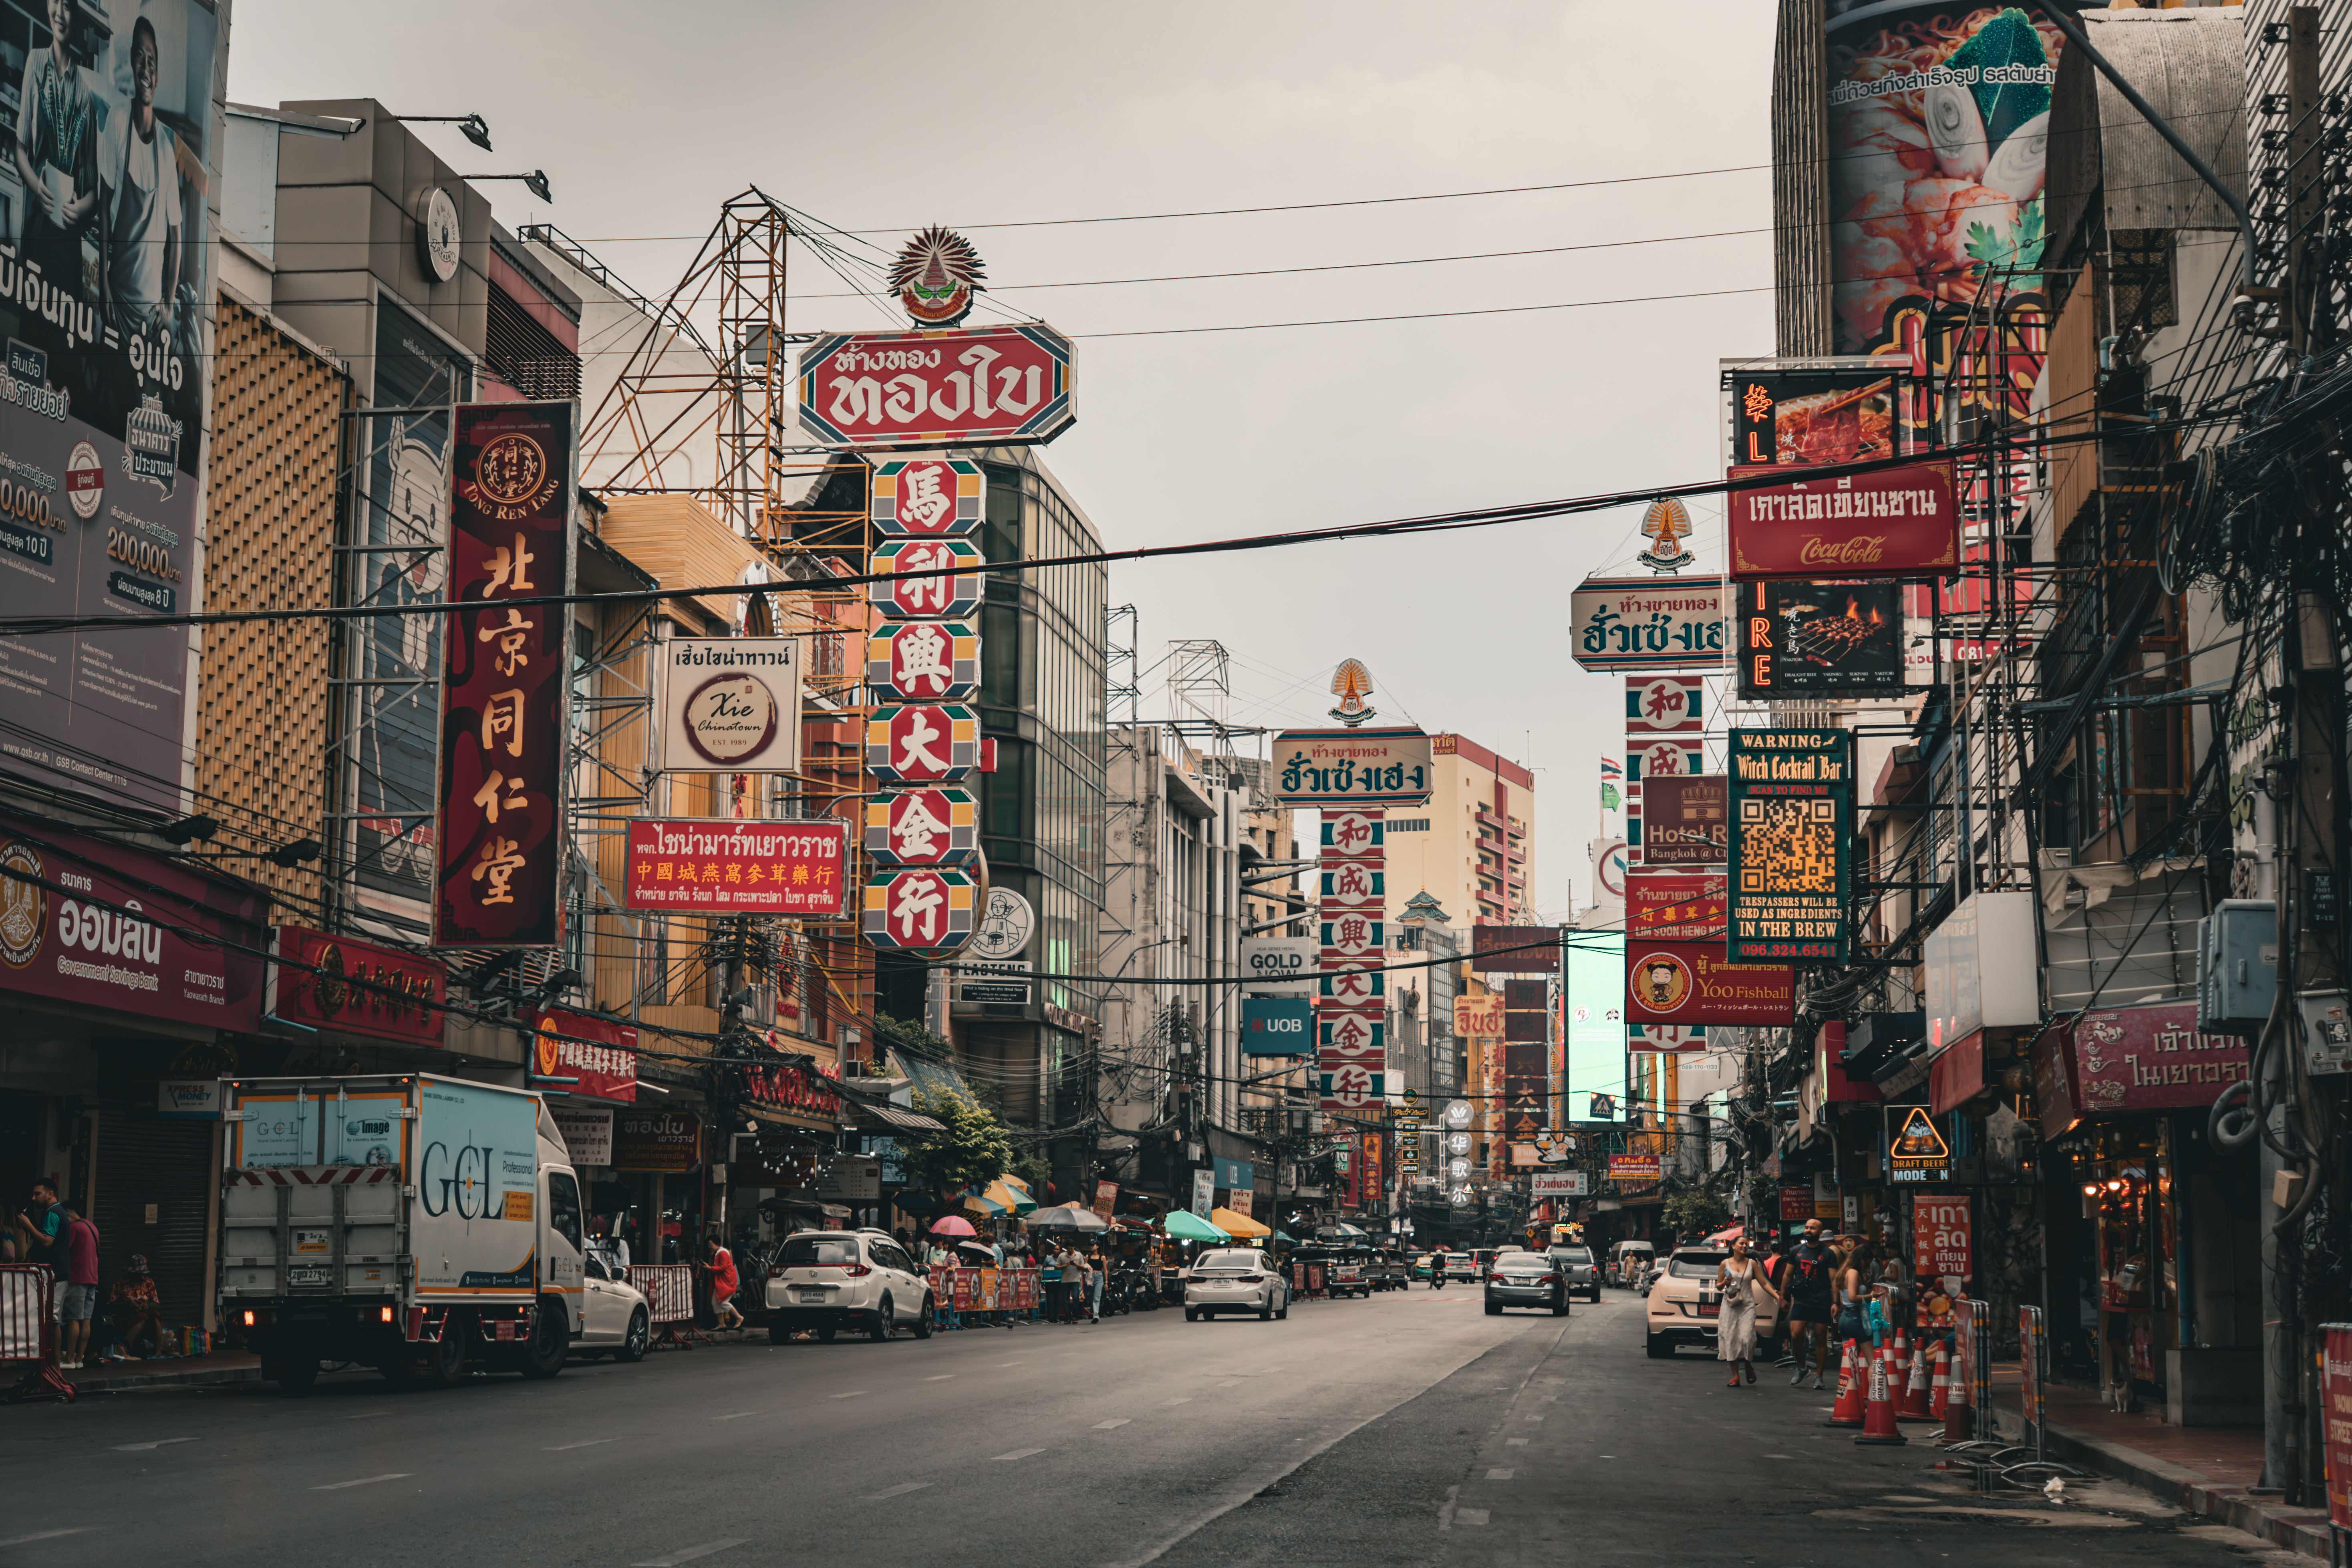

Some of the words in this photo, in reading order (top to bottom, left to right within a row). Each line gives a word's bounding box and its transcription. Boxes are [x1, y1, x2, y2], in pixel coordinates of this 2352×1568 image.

[1983, 62, 2056, 83] รสต้มยำ
[129, 321, 183, 390] อุ่นใจ
[834, 344, 941, 372] ห้างทอง
[12, 352, 40, 378] สินเชื่อ
[829, 344, 1043, 426] ทองใบ
[142, 392, 163, 413] สินเชื่อ
[131, 428, 169, 452] ธนาคาร
[135, 453, 173, 477] ประชาชน
[502, 445, 518, 497] 同仁堂
[17, 462, 57, 493] วงเงินกู้สูงสุด
[77, 473, 95, 488] รู้ก่อนกู้
[1749, 476, 1937, 521] เกาลัดเทียนซาน
[50, 514, 66, 532] บาท
[111, 505, 145, 529] เติมทุนค้าขาย
[147, 522, 179, 548] วงเงินกู้สูงสุด
[26, 535, 38, 554] 10
[40, 537, 47, 557] ปี
[107, 526, 169, 578] 200,000
[169, 566, 181, 583] บาท
[1800, 535, 1888, 565] Coca-Cola
[118, 579, 155, 605] ผ่อนนานสูงสุด
[156, 590, 161, 601] 8
[163, 589, 169, 608] ปี
[1619, 595, 1718, 613] ห้างขายทอง
[18, 645, 27, 654] MRR
[710, 692, 754, 719] Xie
[698, 720, 762, 732] Chinatown
[1311, 743, 1387, 758] ห้างขายทอง
[1741, 735, 1821, 748] WARNING
[3, 743, 48, 763] www.gsb.or.th
[56, 756, 70, 768] GSB
[71, 760, 94, 776] Contact
[95, 768, 113, 783] Center
[114, 774, 127, 787] 1115
[1736, 754, 1769, 780] Witch
[1772, 754, 1815, 781] Cocktail
[1818, 755, 1842, 780] Bar
[1750, 785, 1774, 794] SCAN
[1775, 786, 1788, 794] TO
[1789, 785, 1812, 794] FIND
[1814, 785, 1828, 794] ME
[1650, 848, 1697, 860] Bangkok
[1700, 849, 1712, 859] @
[61, 872, 92, 892] ธนาคาร
[635, 886, 665, 901] จำหน่าย
[669, 887, 689, 901] ยาจีน
[692, 887, 712, 902] รังนก
[715, 886, 730, 902] โสม
[733, 890, 782, 904] กระเพาะปลา
[785, 888, 805, 904] ใบชา
[807, 890, 834, 909] สุราจีน
[1636, 886, 1697, 901] ร้านขายยา
[1740, 897, 1799, 906] TRESPASSERS
[1801, 897, 1824, 906] WILL
[1826, 897, 1837, 906] BE
[1735, 908, 1759, 919] USED
[1761, 908, 1774, 918] AS
[1776, 908, 1843, 919] INGREDIENTS
[59, 900, 162, 964] ออมสิน
[1635, 926, 1651, 937] LIM
[1654, 925, 1679, 936] SOON
[1682, 925, 1707, 936] HENG
[1739, 922, 1756, 937] IN
[1760, 922, 1790, 937] THE
[1795, 922, 1837, 937] BREW
[1741, 944, 1836, 956] 096.324.6541
[1250, 953, 1303, 969] GOLD
[58, 955, 109, 982] Government
[109, 965, 139, 990] Savings
[139, 972, 159, 992] Bank
[184, 968, 224, 990] สาขาเยาวราช
[183, 988, 208, 1002] Yaowarath
[209, 994, 225, 1005] Branch
[1736, 986, 1789, 999] Fishball
[1267, 1018, 1302, 1033] UOB
[166, 1085, 205, 1093] XPRESS
[177, 1092, 211, 1100] MONEY
[362, 1121, 389, 1134] Image
[623, 1113, 684, 1135] ทองใบ
[659, 1134, 695, 1143] เยาวราช
[502, 1160, 532, 1175] Professional
[1893, 1160, 1920, 1168] DRAFT
[1230, 1165, 1238, 1184] UOB
[1893, 1170, 1927, 1182] MODE
[1931, 1206, 1968, 1224] เกา
[1934, 1224, 1967, 1248] ลัด
[1935, 1250, 1966, 1262] เทียน
[1938, 1262, 1965, 1273] ซาน
